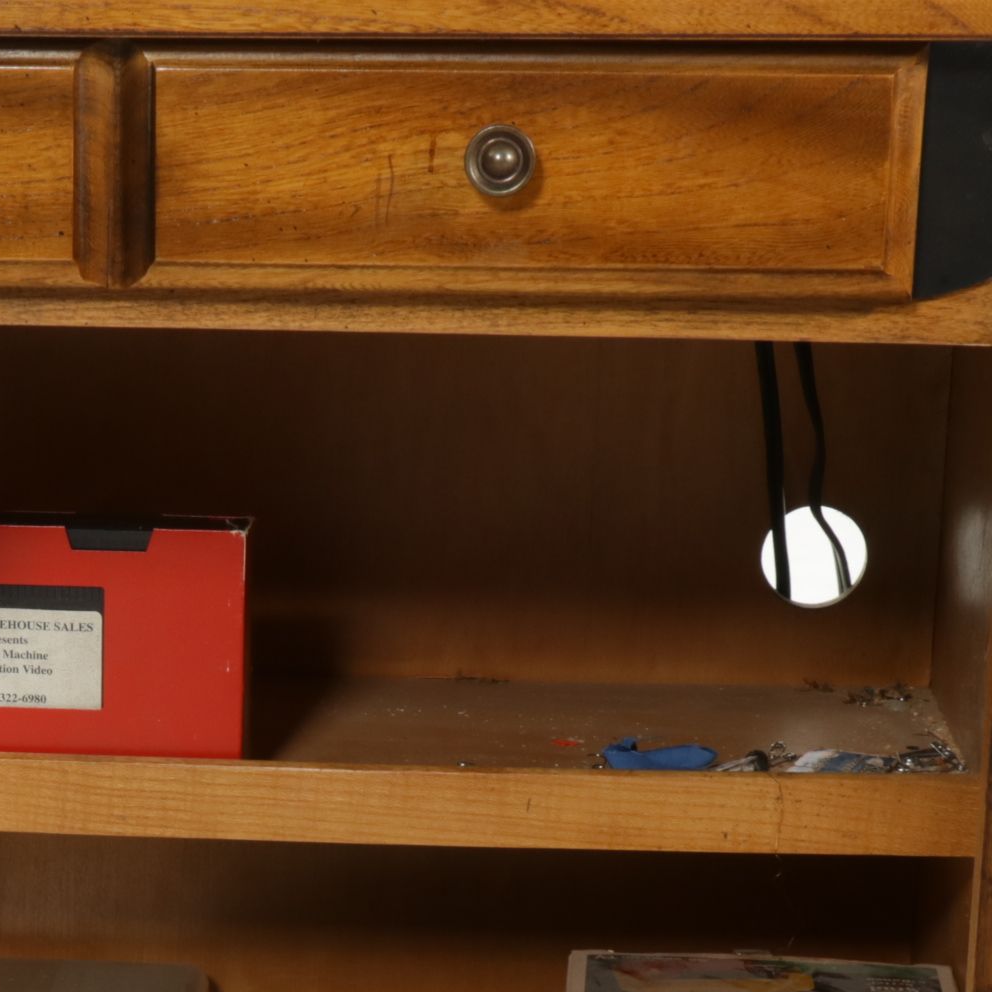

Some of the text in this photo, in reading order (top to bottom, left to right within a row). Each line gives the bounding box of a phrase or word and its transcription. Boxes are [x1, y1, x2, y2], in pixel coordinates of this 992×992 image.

[54, 622, 94, 632] SALES
[2, 649, 49, 660] Machine
[23, 664, 53, 675] Video
